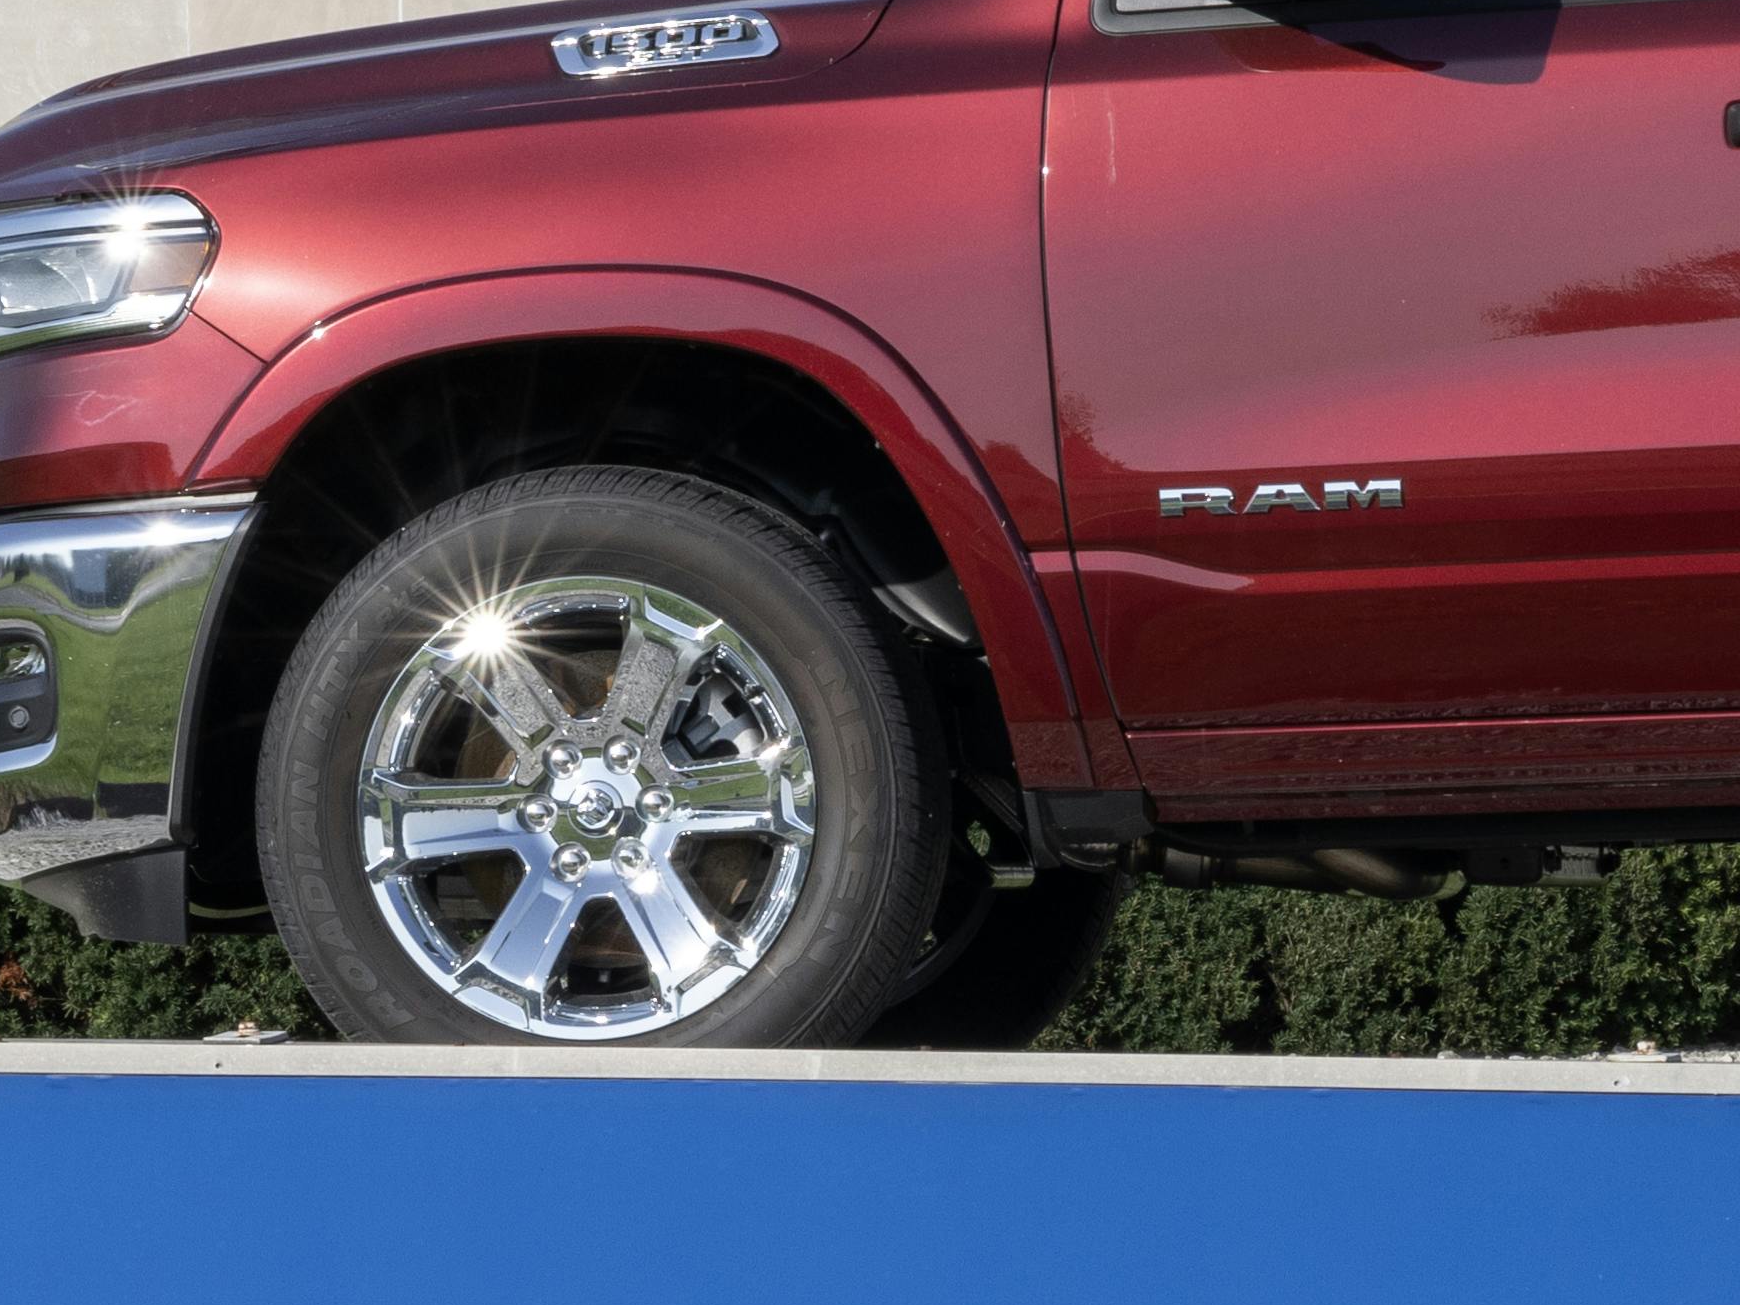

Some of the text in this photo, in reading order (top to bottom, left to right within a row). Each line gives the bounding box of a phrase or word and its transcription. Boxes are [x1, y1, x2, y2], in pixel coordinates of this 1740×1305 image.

[1158, 478, 1403, 517] RAM
[304, 620, 374, 737] HTX
[291, 761, 415, 1031] ROADIAN
[805, 656, 878, 971] NEXEN
